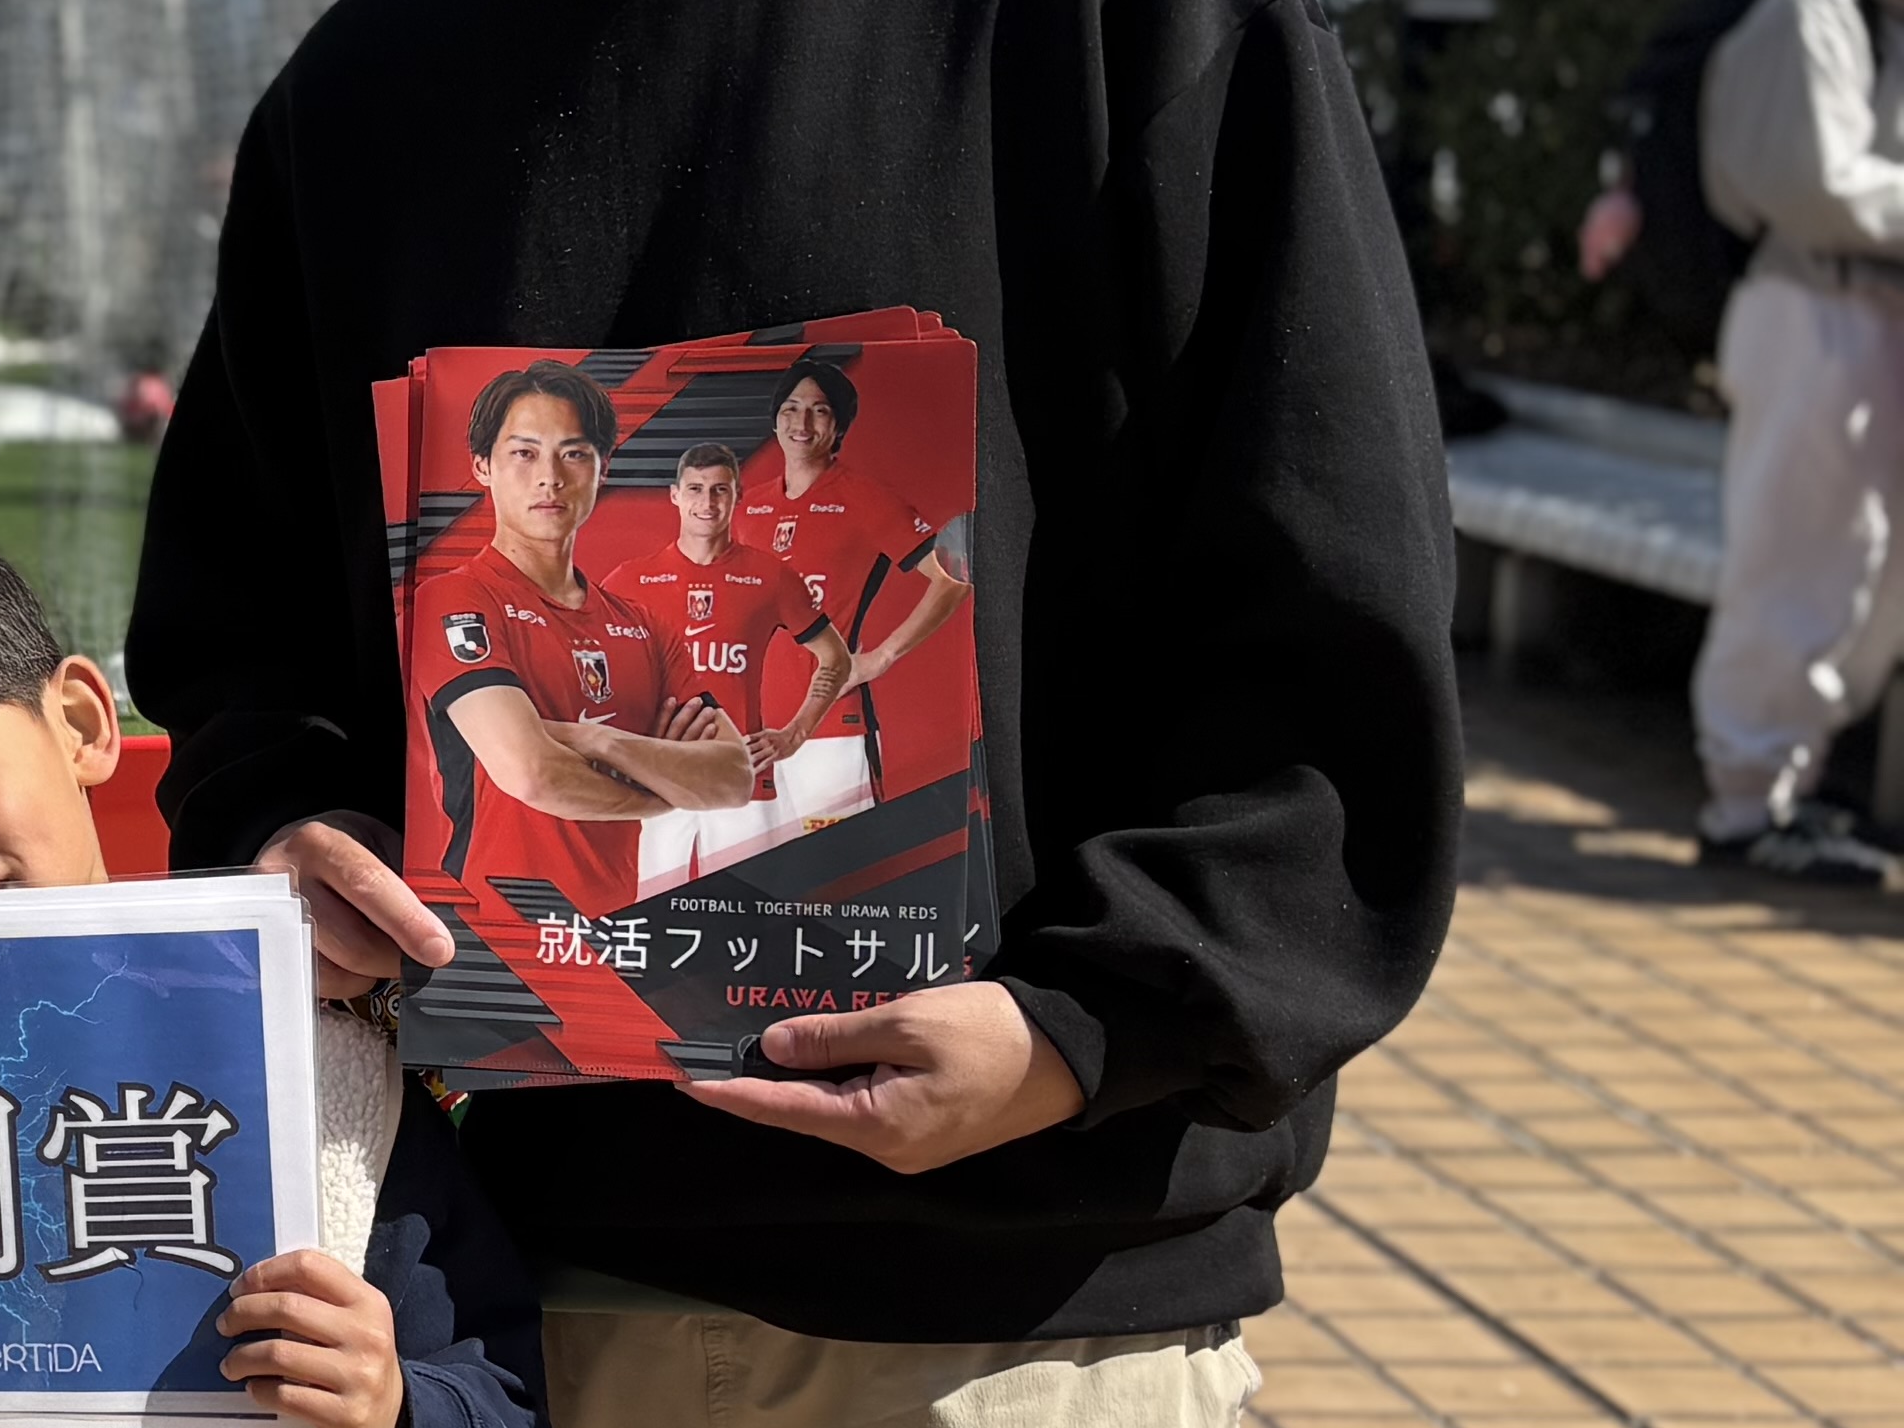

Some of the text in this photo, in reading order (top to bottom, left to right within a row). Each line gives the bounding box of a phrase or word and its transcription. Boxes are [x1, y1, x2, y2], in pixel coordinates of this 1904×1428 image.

[683, 640, 748, 674] LUS
[671, 897, 938, 921] FOOTBALL TOGETHER URAWA REDS
[535, 910, 949, 982] 就活フットサル
[726, 985, 838, 1011] URAWA
